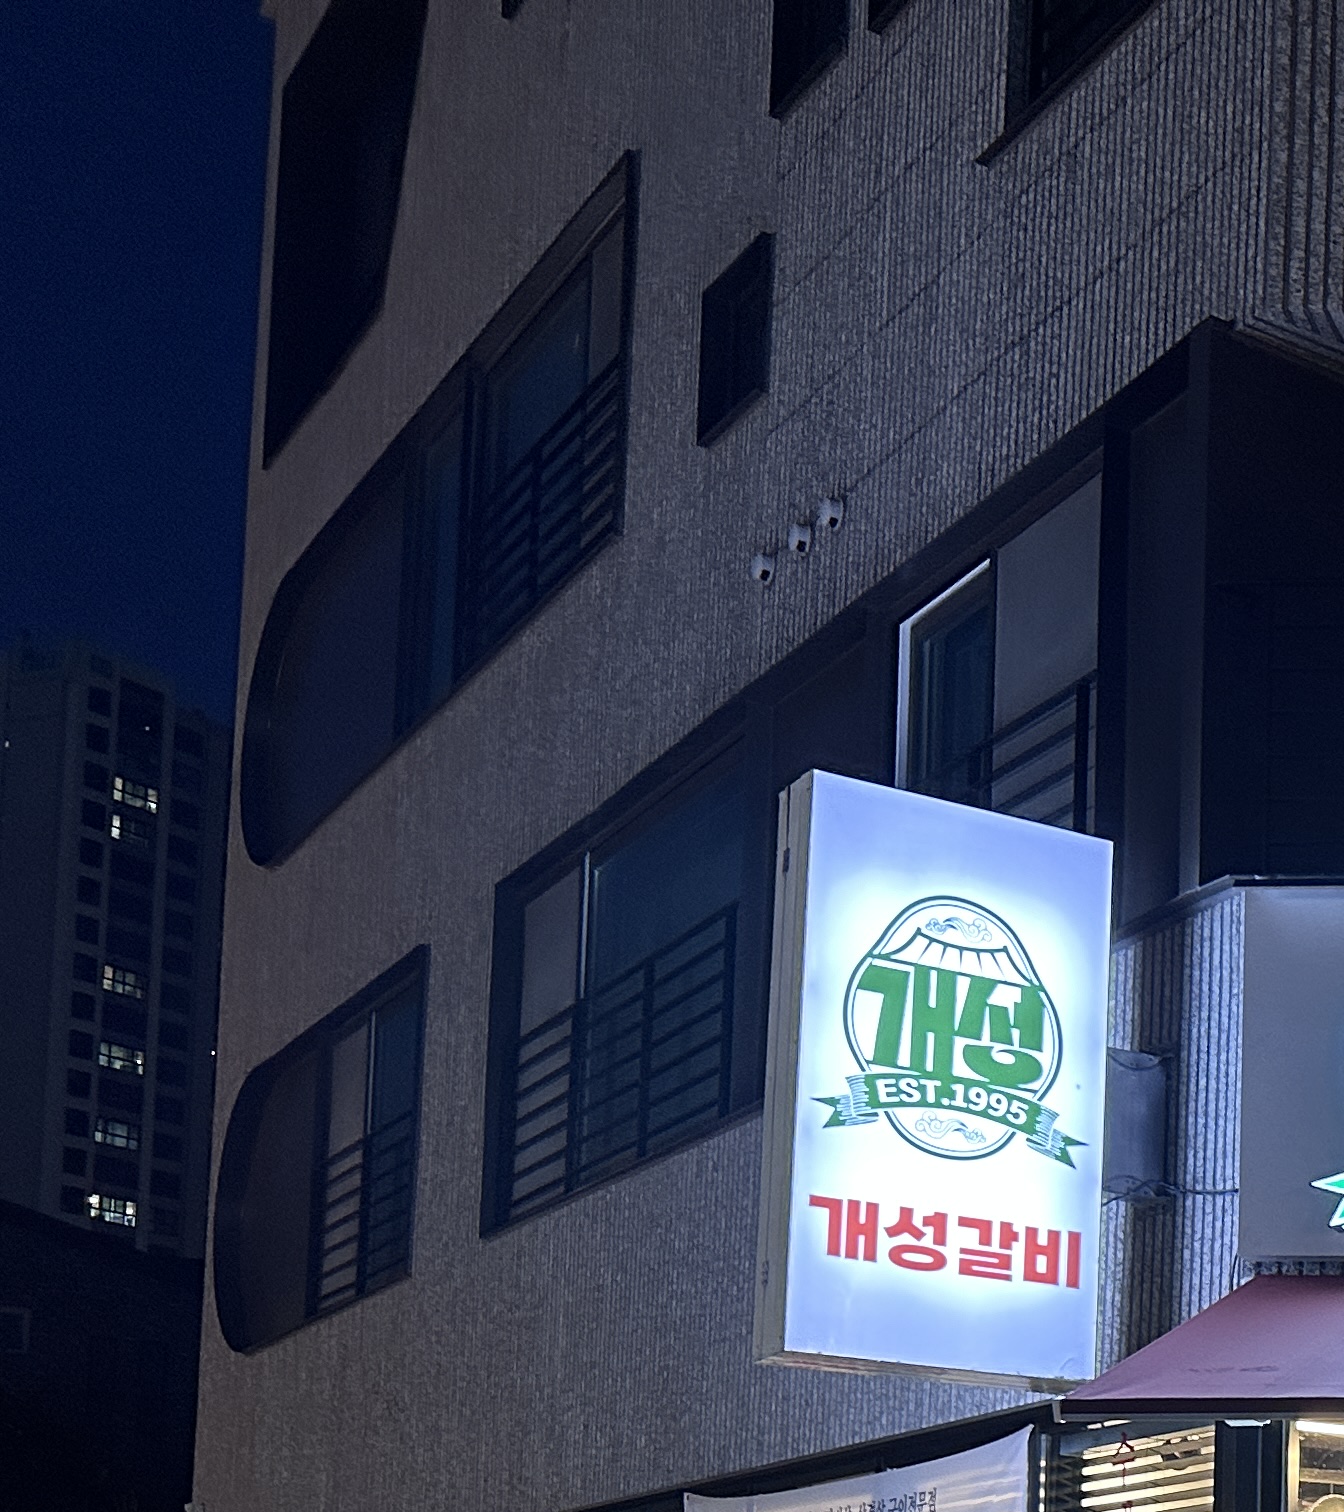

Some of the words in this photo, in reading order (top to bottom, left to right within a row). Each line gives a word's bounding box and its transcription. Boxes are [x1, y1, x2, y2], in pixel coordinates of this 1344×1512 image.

[857, 957, 1047, 1090] 개성
[876, 1075, 1028, 1127] EST.1995
[808, 1194, 1082, 1291] 개성갈비
